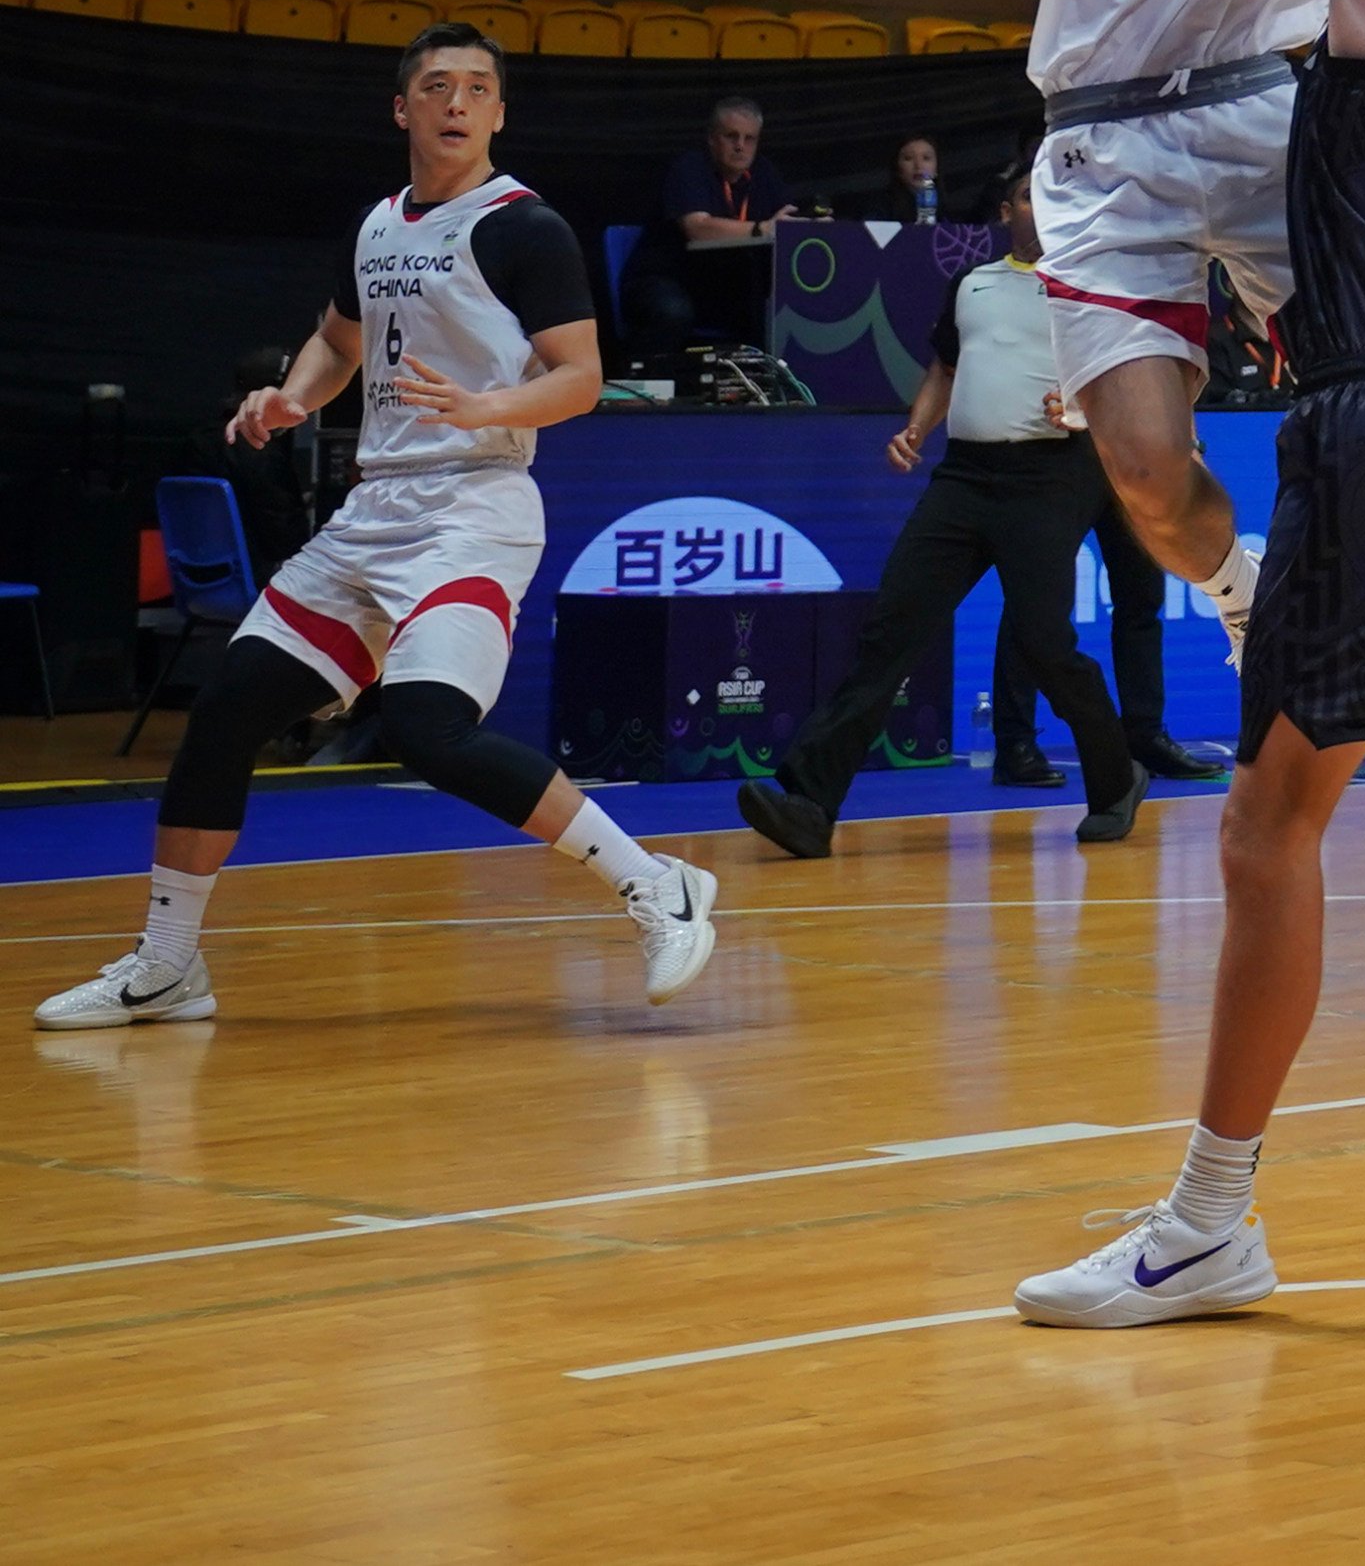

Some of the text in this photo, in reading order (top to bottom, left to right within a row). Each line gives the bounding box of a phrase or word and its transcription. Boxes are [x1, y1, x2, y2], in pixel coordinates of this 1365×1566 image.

[359, 254, 455, 277] HONG KONG
[367, 278, 424, 299] CHINA
[386, 312, 402, 367] 6
[614, 527, 784, 586] 百岁山
[744, 680, 765, 695] CUP
